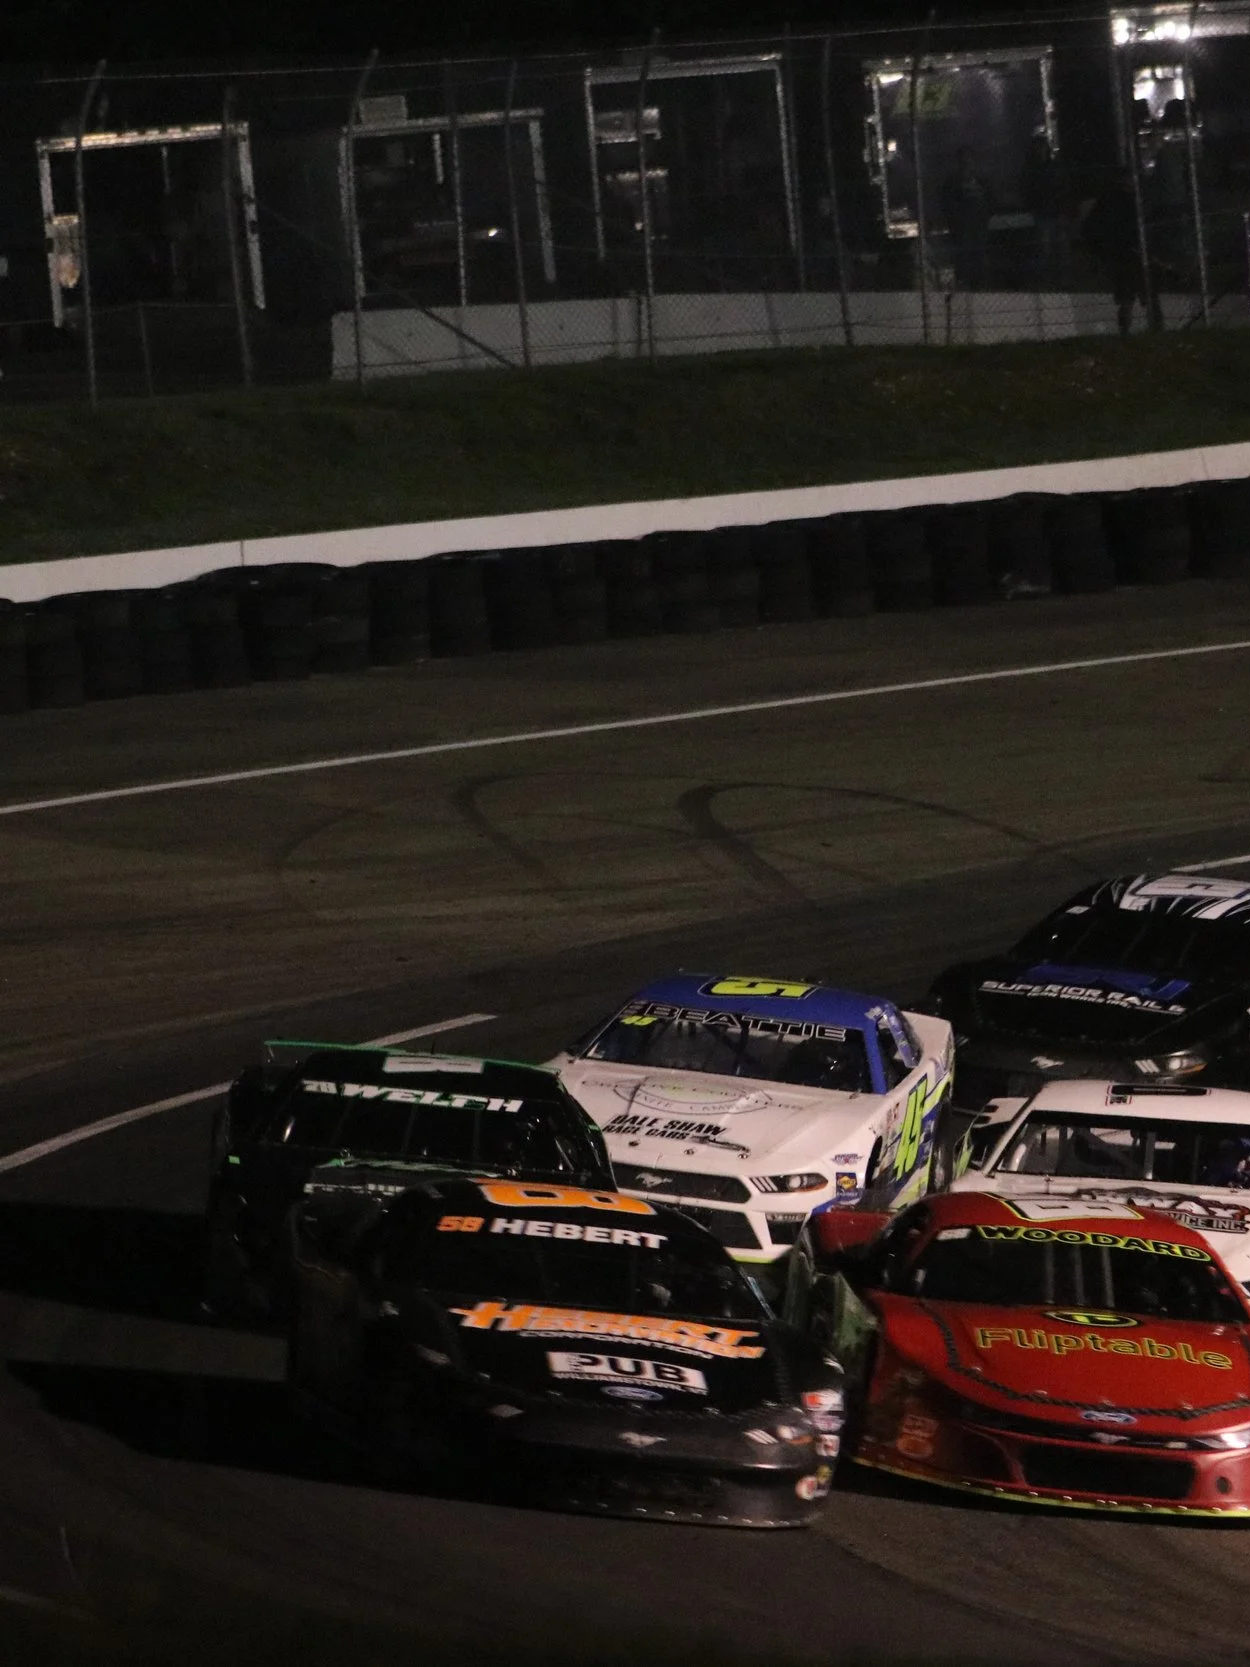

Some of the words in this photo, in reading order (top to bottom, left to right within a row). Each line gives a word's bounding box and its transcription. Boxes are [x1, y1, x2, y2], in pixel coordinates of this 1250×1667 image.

[981, 980, 1104, 999] SUPERIOR
[644, 1003, 848, 1042] BEATTIE
[341, 1083, 524, 1113] WELCH
[611, 1115, 657, 1127] DALE
[663, 1120, 727, 1136] SHAW
[645, 1130, 693, 1141] CARS
[489, 1218, 668, 1249] HEBERT
[976, 1225, 1212, 1263] WOODARD
[975, 1327, 1234, 1370] Fliptable
[570, 1353, 689, 1384] PUB
